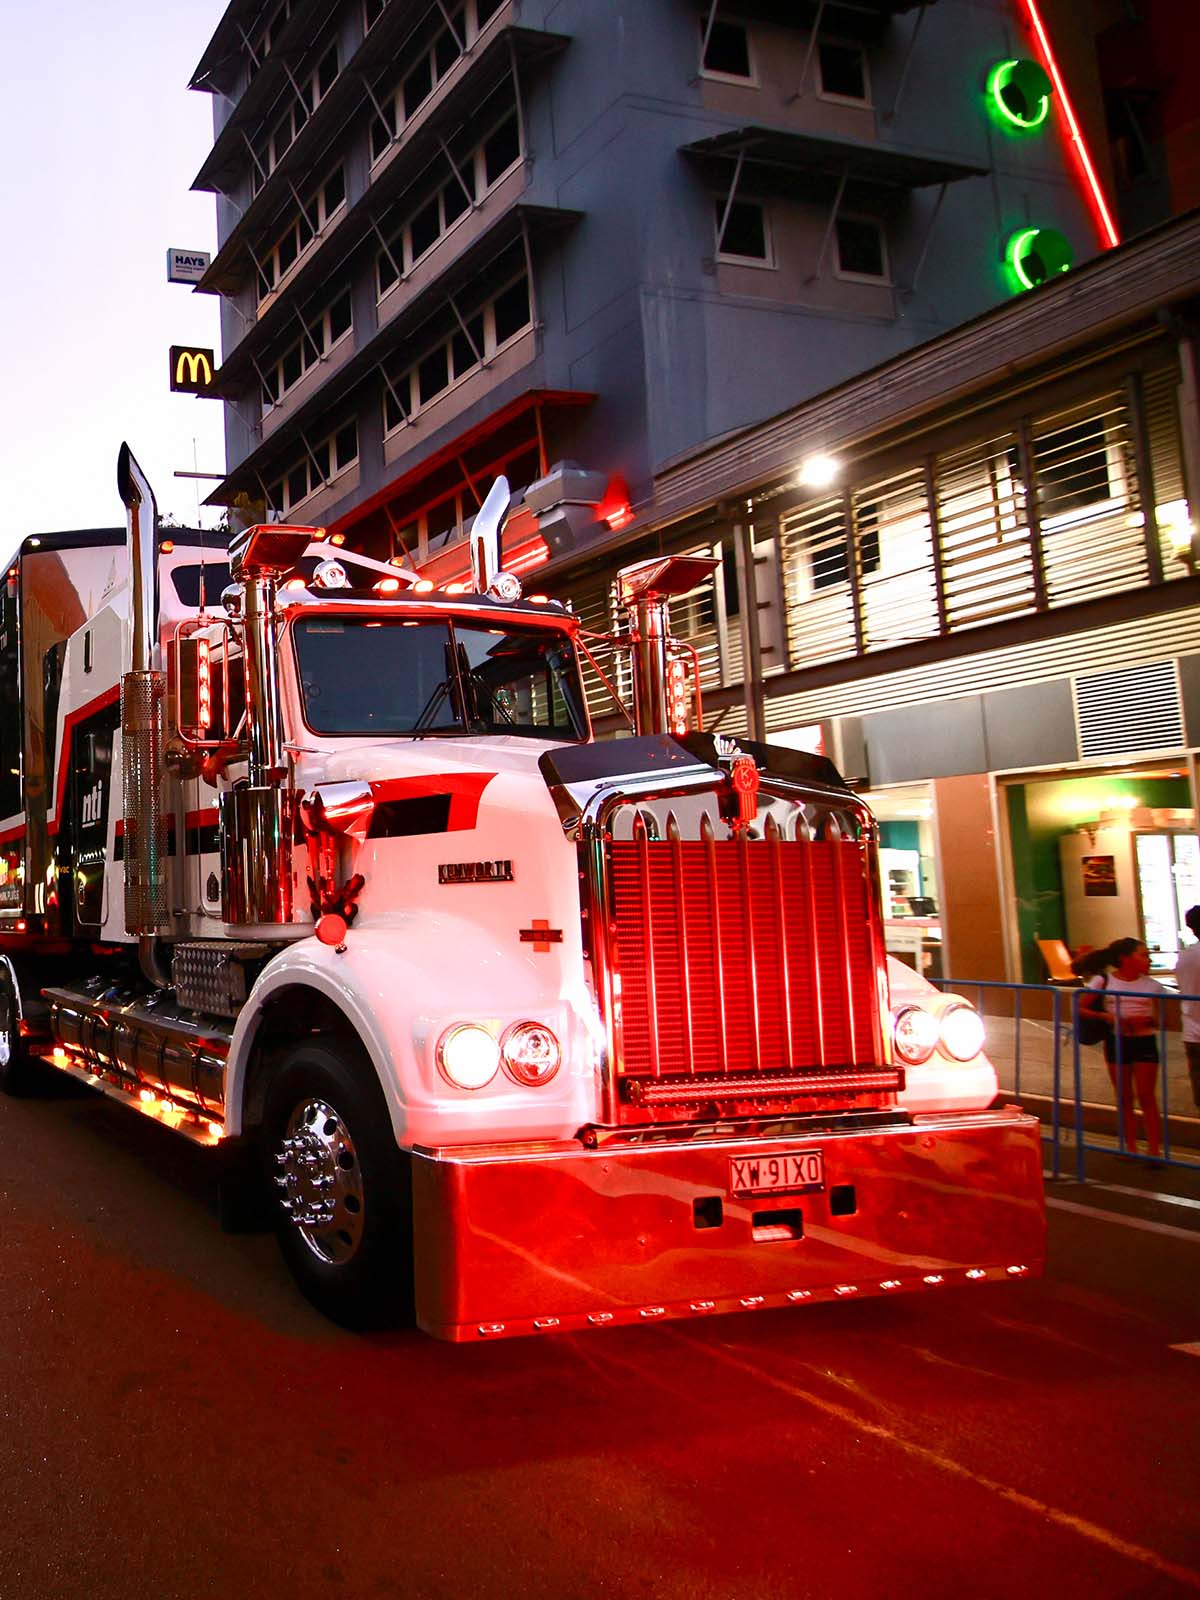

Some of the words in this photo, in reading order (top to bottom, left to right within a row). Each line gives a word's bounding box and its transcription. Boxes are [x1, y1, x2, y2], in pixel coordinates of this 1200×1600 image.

[175, 255, 205, 267] HAYS
[82, 779, 102, 822] nti
[437, 860, 512, 881] KENWORTH
